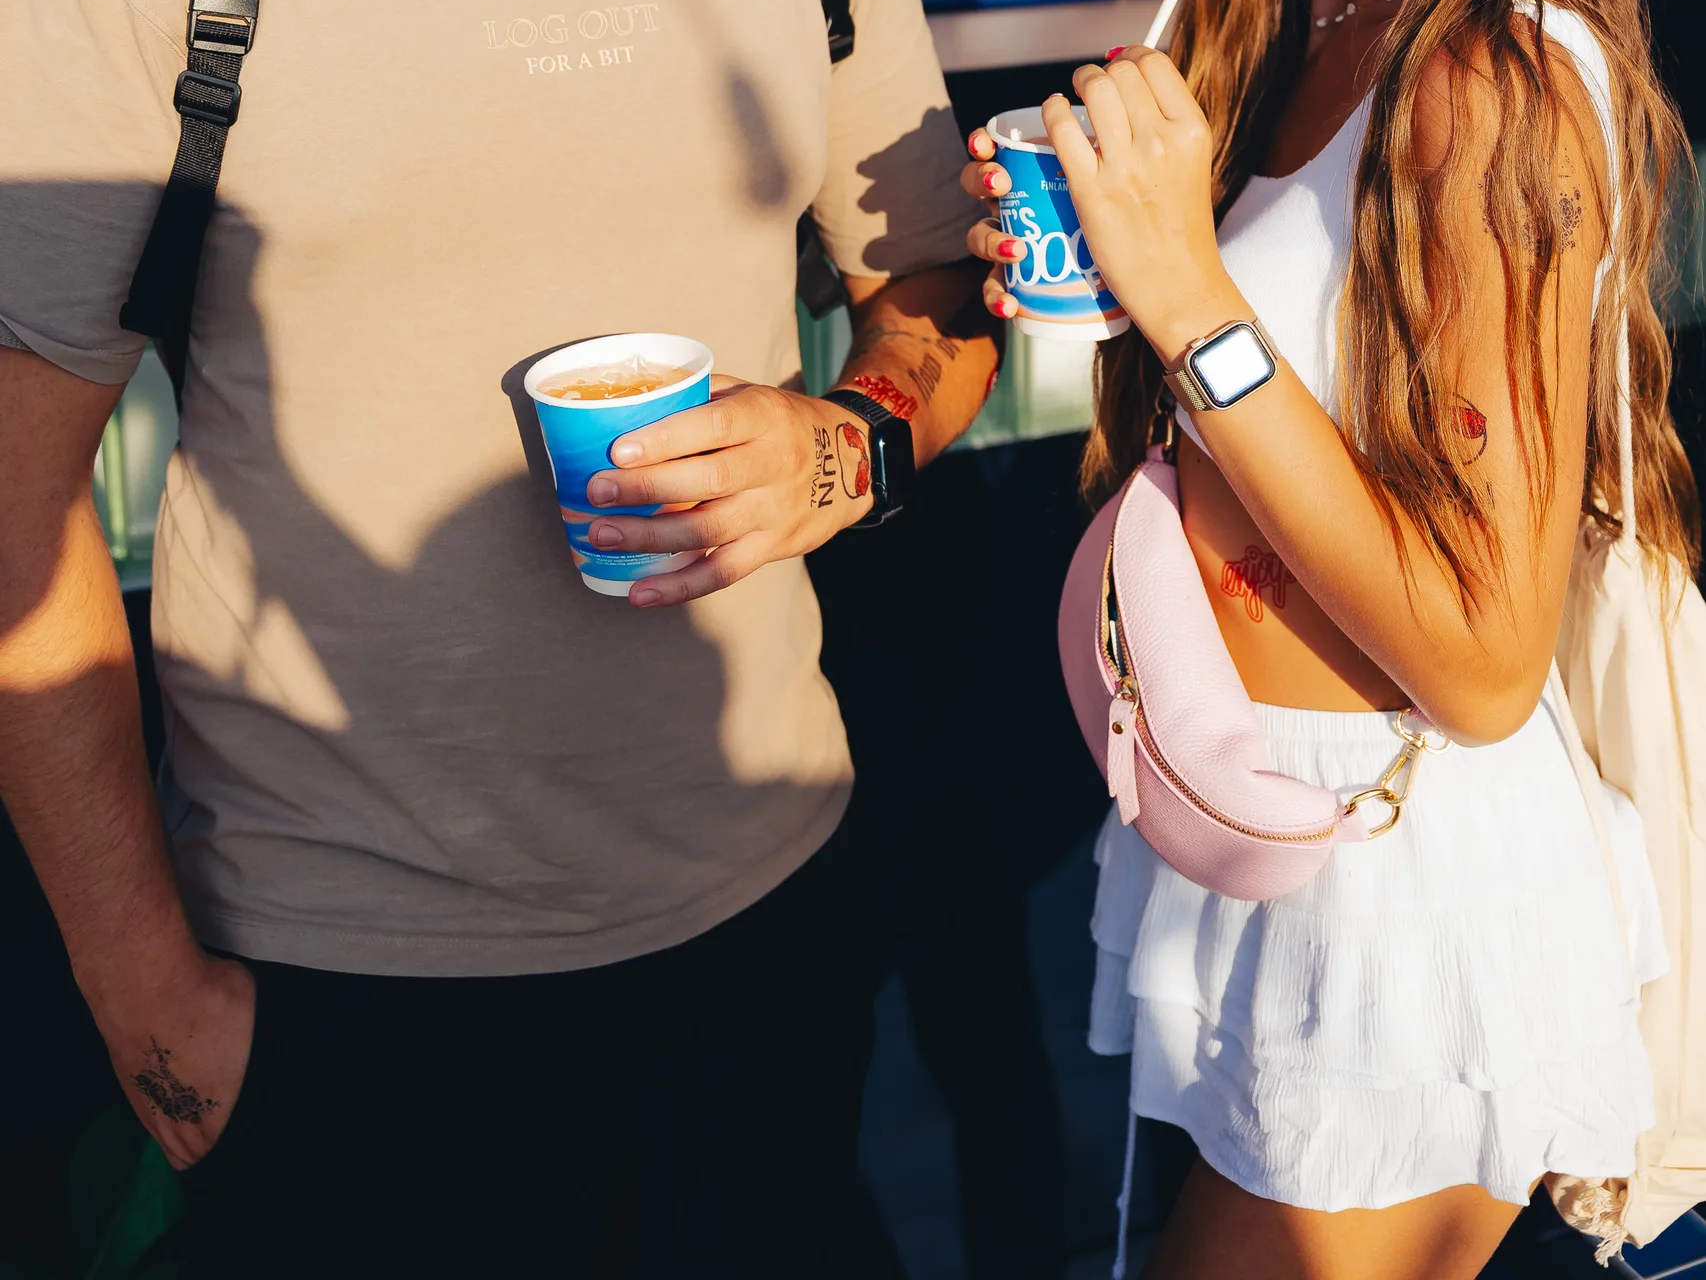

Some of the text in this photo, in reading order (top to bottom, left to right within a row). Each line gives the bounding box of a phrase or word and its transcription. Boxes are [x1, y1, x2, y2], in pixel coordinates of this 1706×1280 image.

[482, 3, 659, 50] LOG OUT
[526, 46, 635, 75] FOR A BIT
[1040, 179, 1069, 192] FINLAN
[1000, 206, 1042, 241] IT'S
[809, 424, 824, 508] FESTIVAL
[817, 427, 837, 508] SUN
